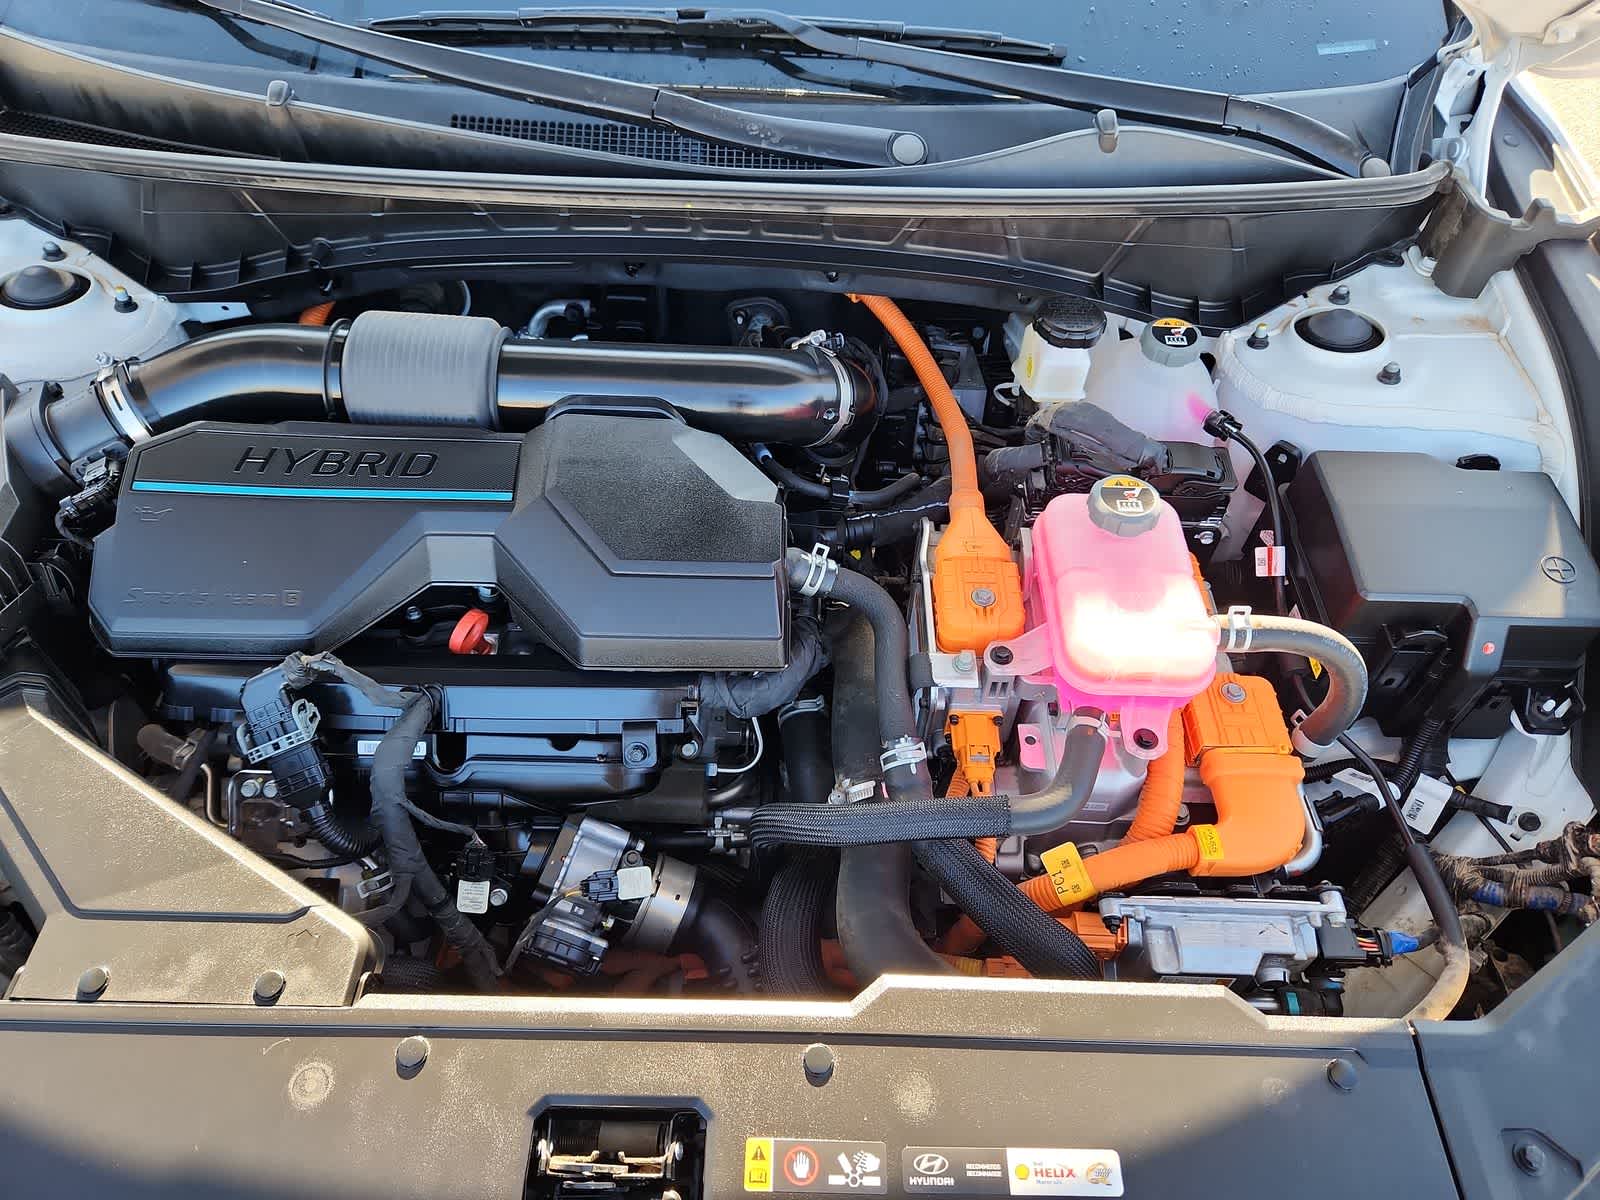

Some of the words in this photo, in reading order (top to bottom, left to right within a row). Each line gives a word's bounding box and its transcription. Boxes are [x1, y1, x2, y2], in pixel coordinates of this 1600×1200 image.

[233, 446, 439, 479] HYBRID
[121, 585, 277, 607] Smartsream
[1051, 869, 1069, 895] PC1
[909, 1176, 954, 1186] HYUNDAI
[1034, 1168, 1076, 1178] HELIX
